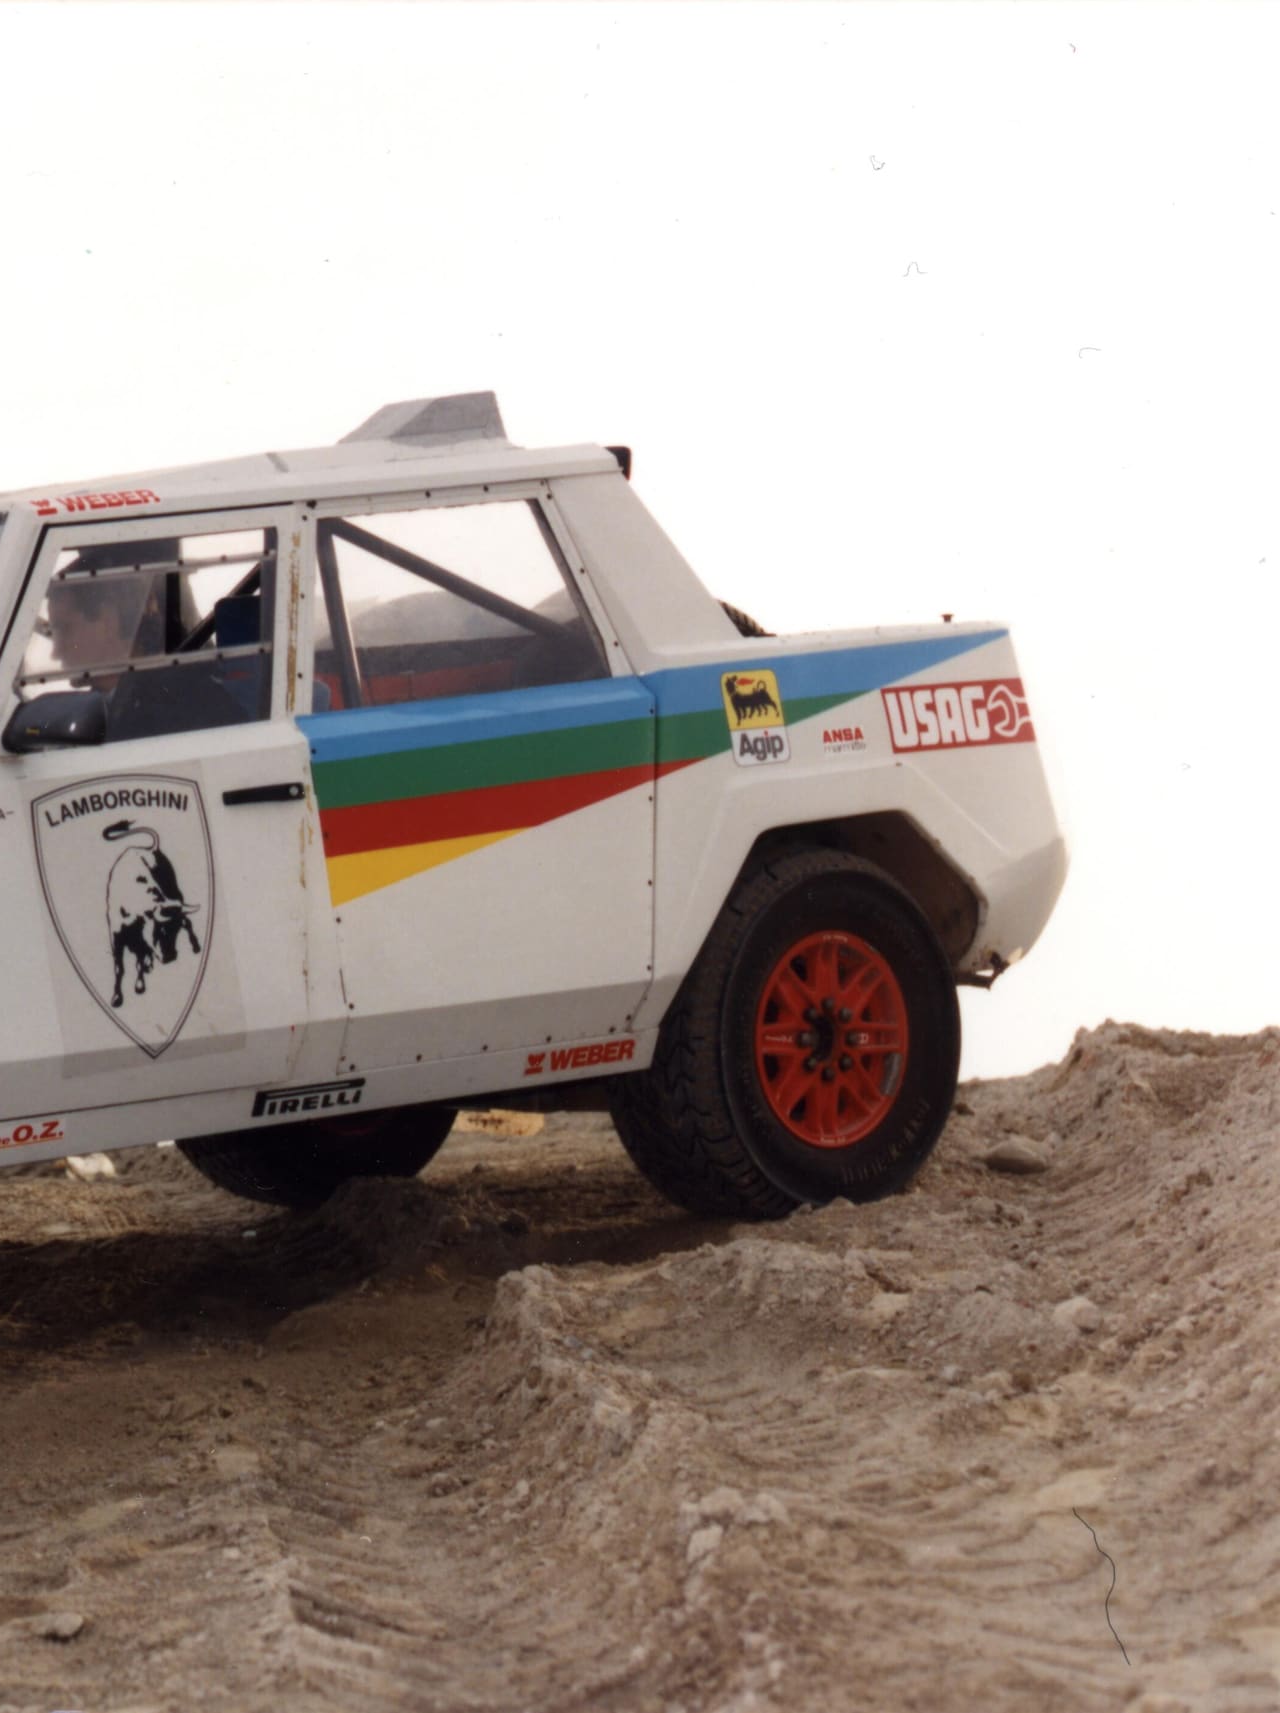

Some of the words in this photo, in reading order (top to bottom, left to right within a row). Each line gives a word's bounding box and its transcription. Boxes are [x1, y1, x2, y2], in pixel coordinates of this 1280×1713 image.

[55, 489, 161, 512] WEBER
[884, 685, 991, 749] USAG
[739, 729, 784, 761] Agip
[822, 726, 865, 744] ANSA
[44, 788, 188, 828] LAMBORGHINI
[550, 1039, 636, 1072] WEBER
[251, 1077, 366, 1118] PIRELLI
[12, 1120, 64, 1144] O.Z.
